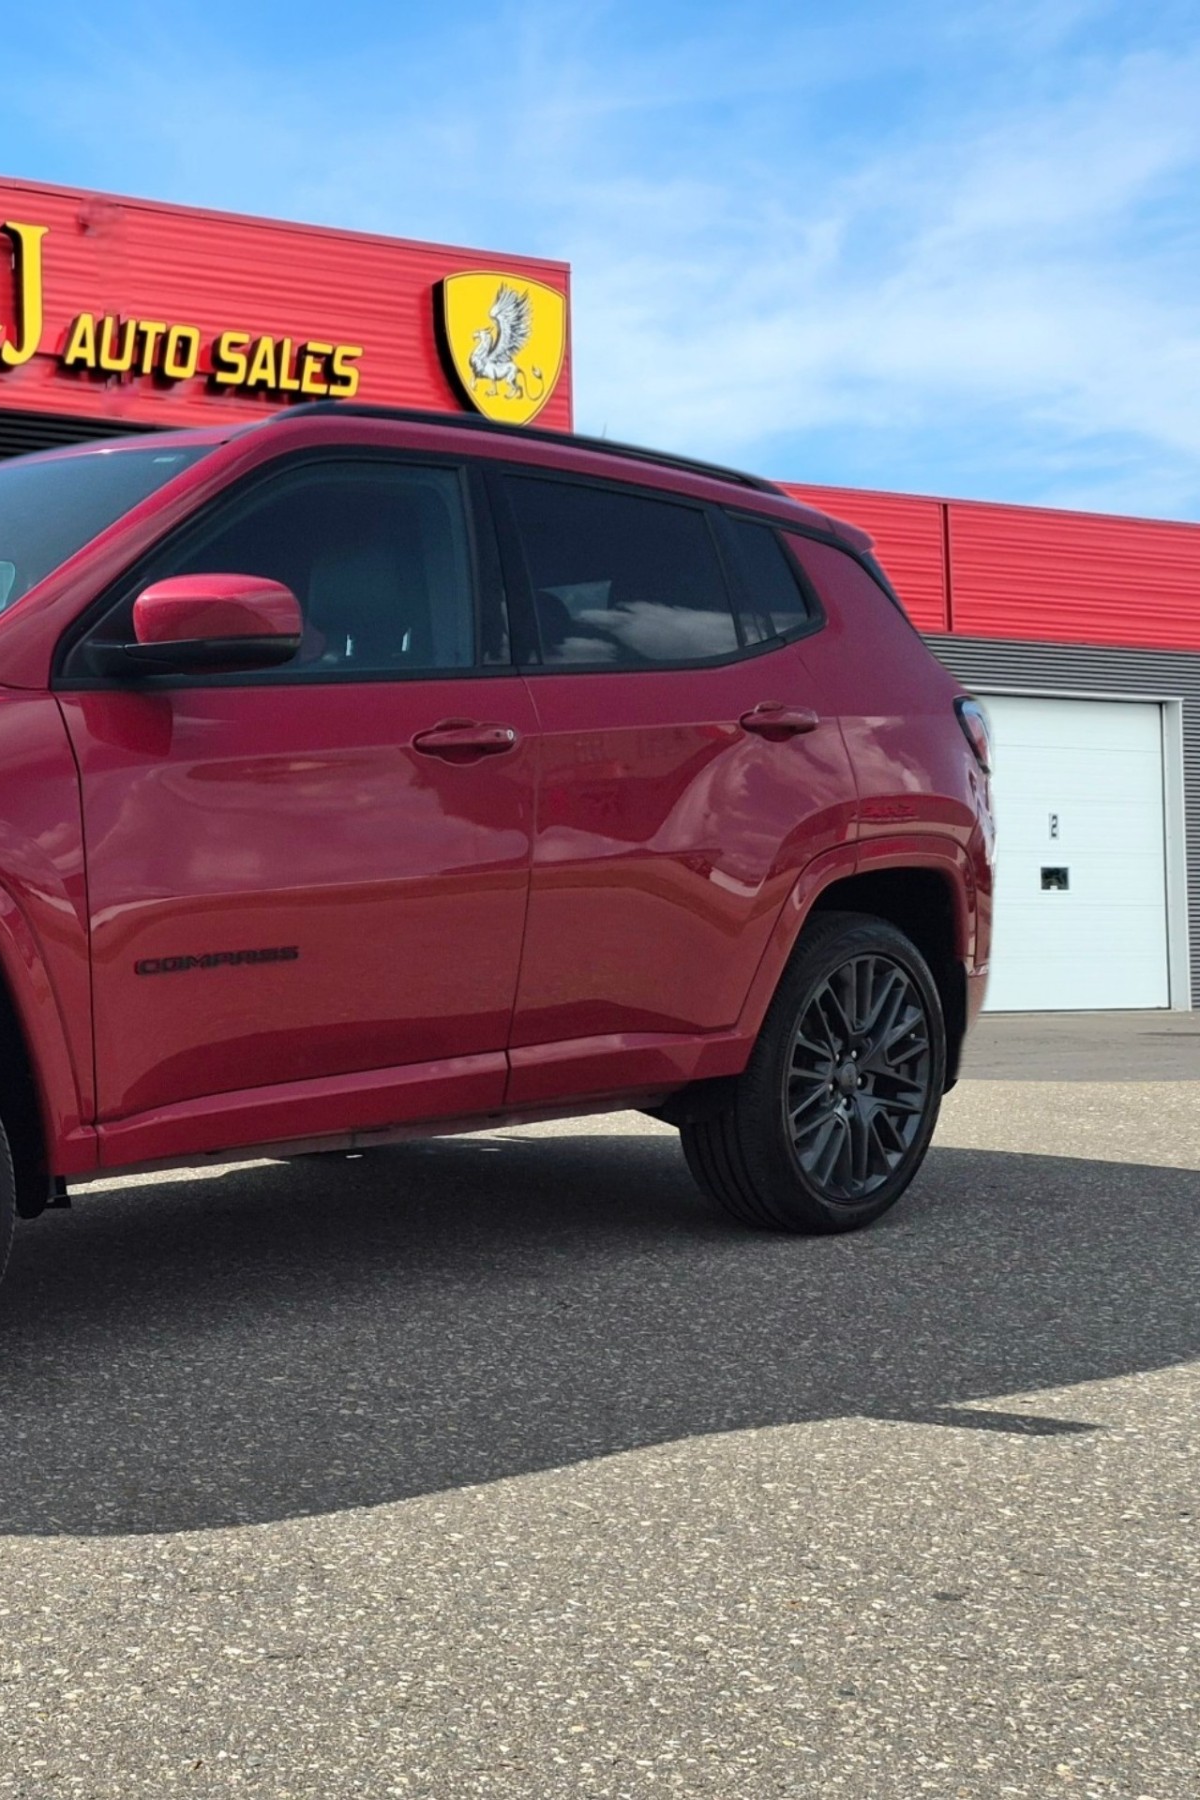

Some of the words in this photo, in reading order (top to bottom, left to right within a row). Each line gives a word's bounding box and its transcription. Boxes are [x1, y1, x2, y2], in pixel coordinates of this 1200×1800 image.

[65, 312, 201, 379] AUTO
[215, 330, 364, 397] SALES
[1049, 813, 1059, 838] 2
[134, 946, 299, 975] COMPASS
